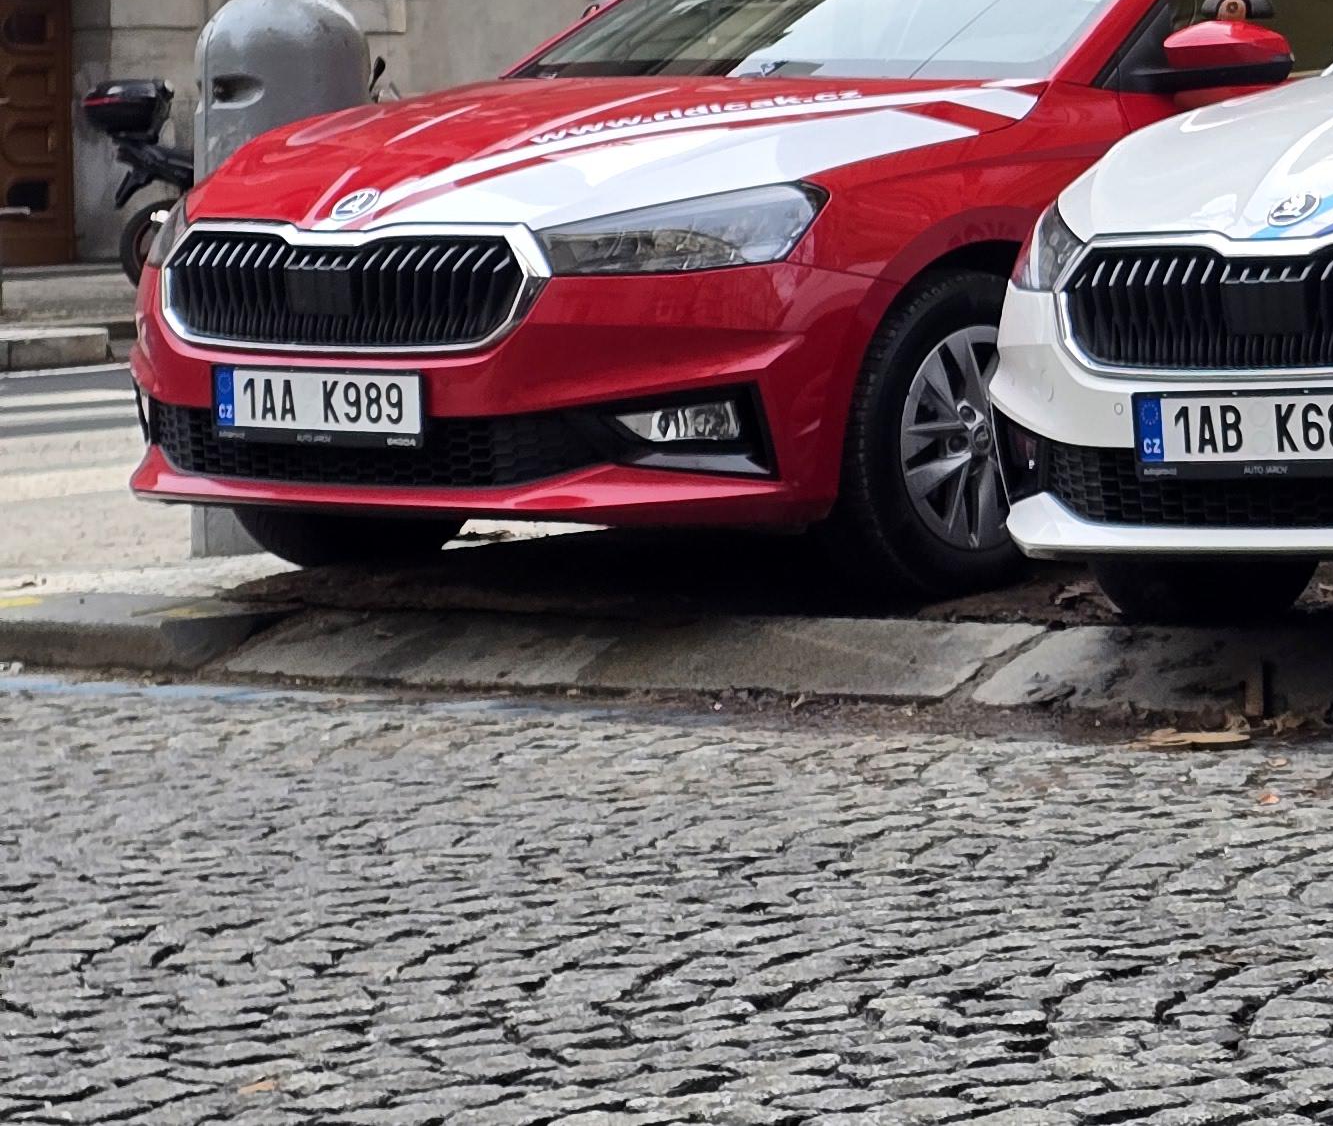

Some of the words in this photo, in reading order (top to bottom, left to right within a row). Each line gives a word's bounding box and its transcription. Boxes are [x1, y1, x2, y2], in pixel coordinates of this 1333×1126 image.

[529, 90, 863, 145] www.ridicak.cz
[217, 403, 234, 419] CZ
[242, 377, 297, 422] 1AA
[321, 379, 404, 425] K989
[1142, 438, 1162, 455] CZ
[1173, 404, 1244, 454] 1AB
